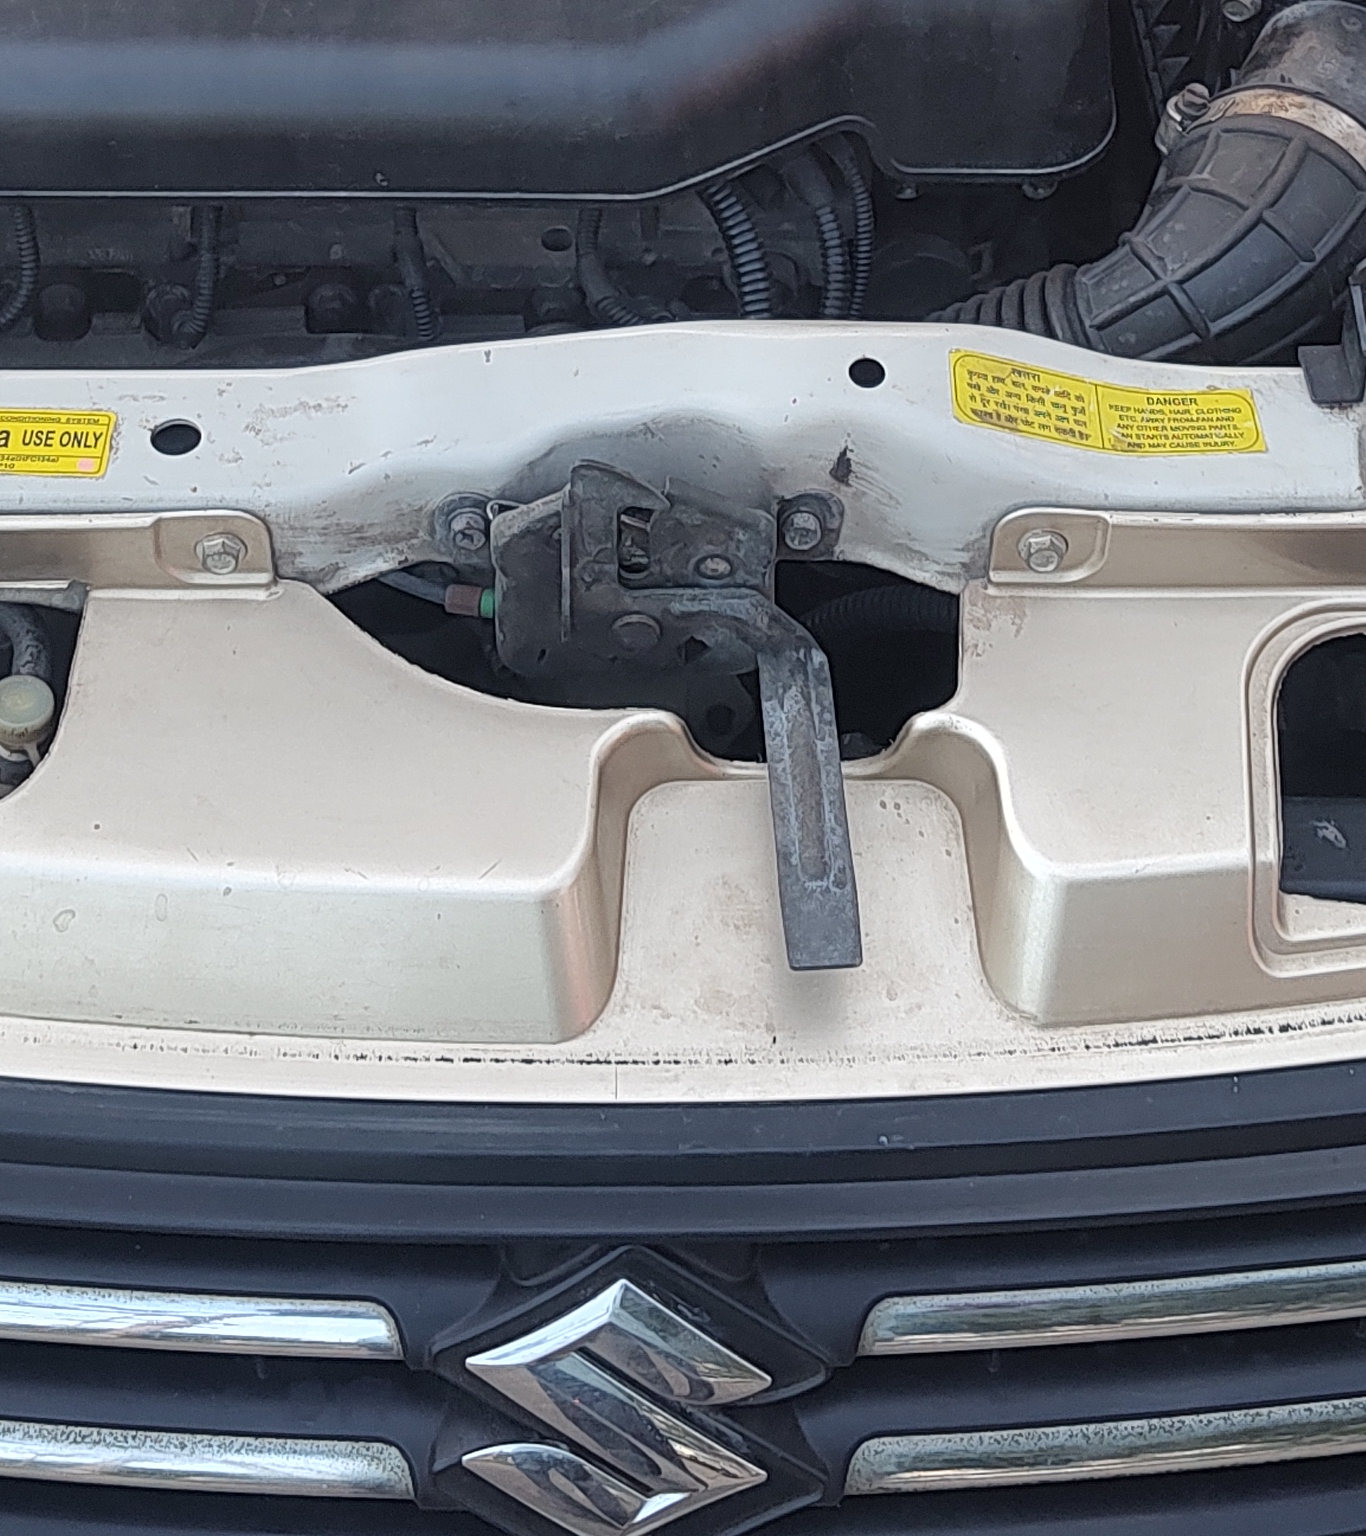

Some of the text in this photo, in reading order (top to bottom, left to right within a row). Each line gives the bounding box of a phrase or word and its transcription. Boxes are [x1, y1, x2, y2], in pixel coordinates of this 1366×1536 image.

[1146, 396, 1198, 406] DANGER
[22, 429, 56, 447] USE
[59, 431, 103, 449] ONLY
